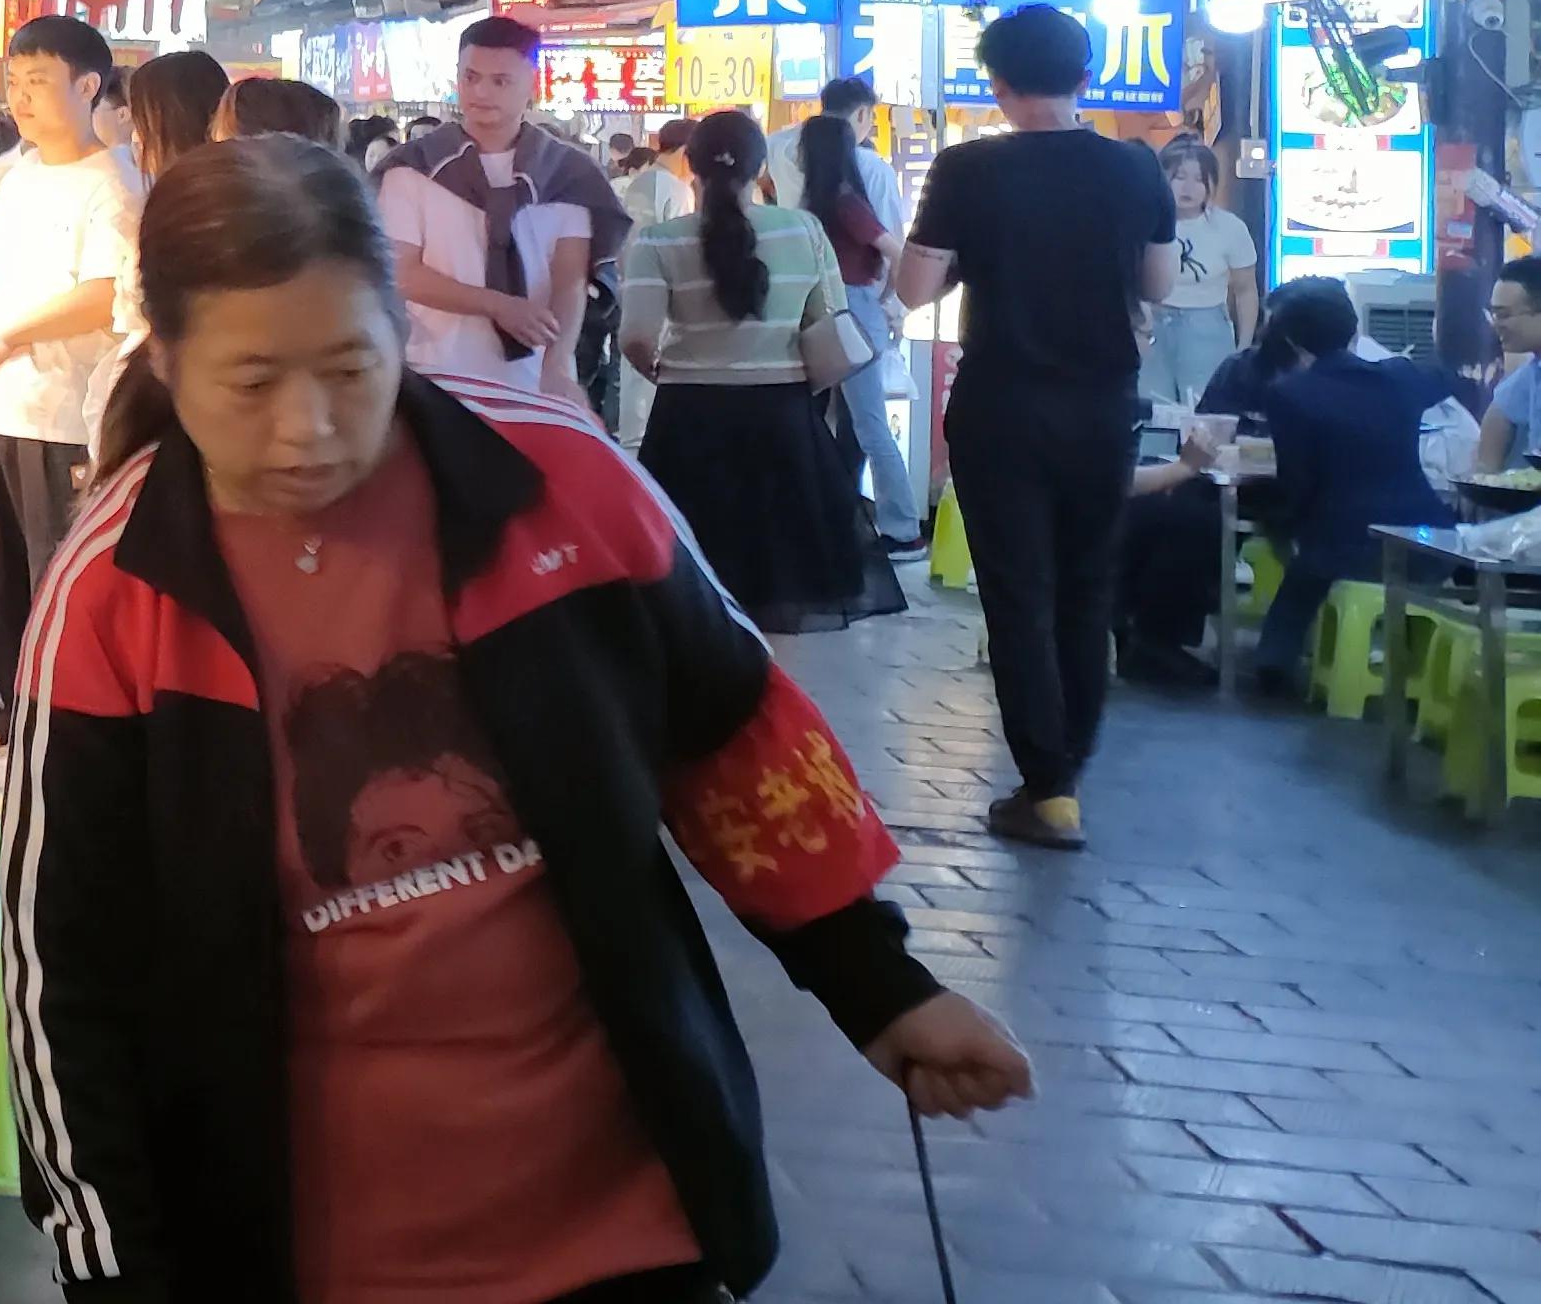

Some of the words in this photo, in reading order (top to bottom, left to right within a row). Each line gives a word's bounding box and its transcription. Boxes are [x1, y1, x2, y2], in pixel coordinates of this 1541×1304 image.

[853, 3, 1173, 88] 无骨爪
[302, 850, 488, 933] DIFFERENT
